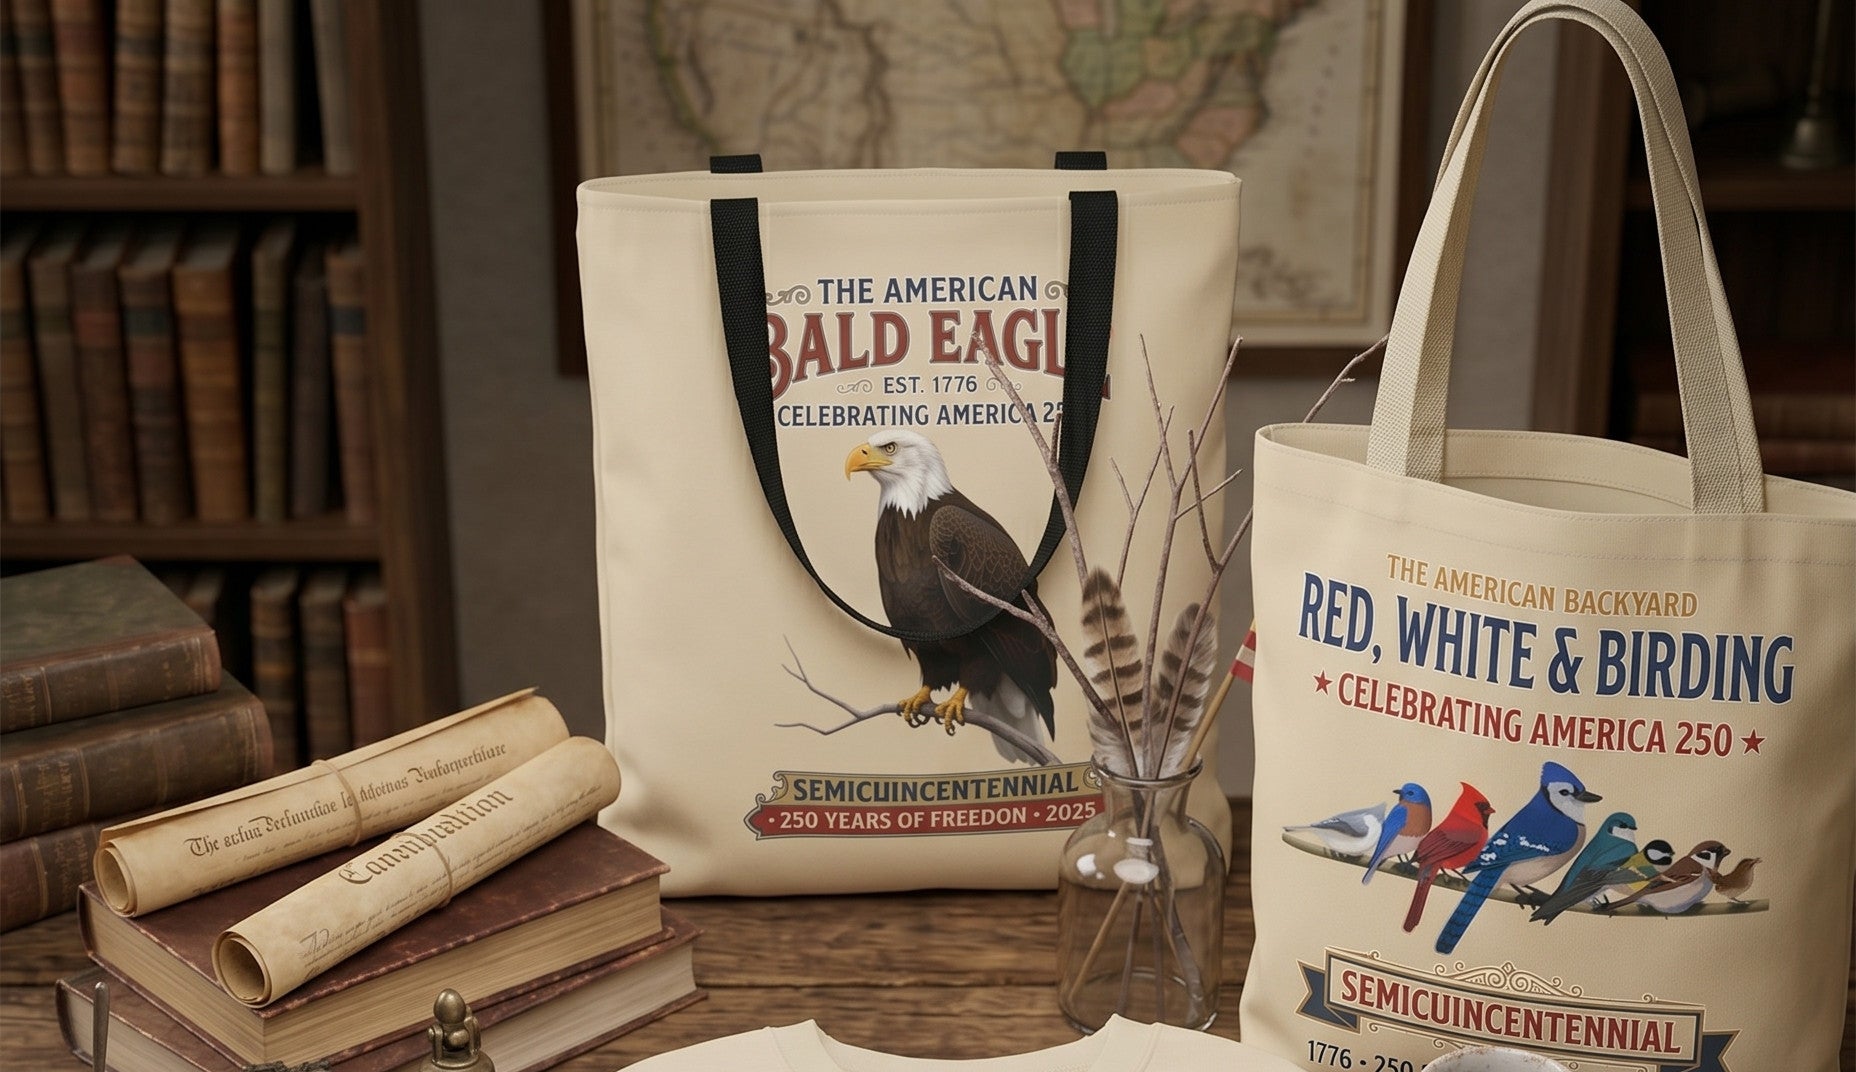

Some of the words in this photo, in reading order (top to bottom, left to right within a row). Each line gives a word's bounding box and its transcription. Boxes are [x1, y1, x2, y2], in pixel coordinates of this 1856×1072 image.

[817, 278, 874, 304] THE
[884, 276, 1037, 303] AMERICAN
[884, 376, 925, 393] EST.
[933, 375, 977, 392] 1776
[778, 405, 929, 426] CELEBRATING
[936, 403, 1037, 425] AMERICA
[1388, 554, 1428, 586] THE
[1434, 566, 1555, 613] AMERICAN
[1564, 588, 1698, 617] BACKYARD
[1299, 571, 1381, 663] RED,
[1397, 594, 1537, 689] WHITE
[1548, 627, 1583, 694] &
[1596, 629, 1794, 704] BIRDING
[1338, 673, 1522, 742] CELEBRATING
[1529, 713, 1666, 753] AMERICA
[1675, 722, 1733, 757] 250
[793, 771, 1079, 802] SEMICUINCENTENNIAL
[780, 811, 818, 829] 250
[825, 811, 891, 829] YEARS
[897, 810, 923, 828] OF
[930, 807, 1027, 827] FREEDON
[1046, 801, 1096, 822] 2025
[1341, 969, 1682, 1054] SEMICUINCENTENNIAL
[1308, 1040, 1352, 1069] 1776
